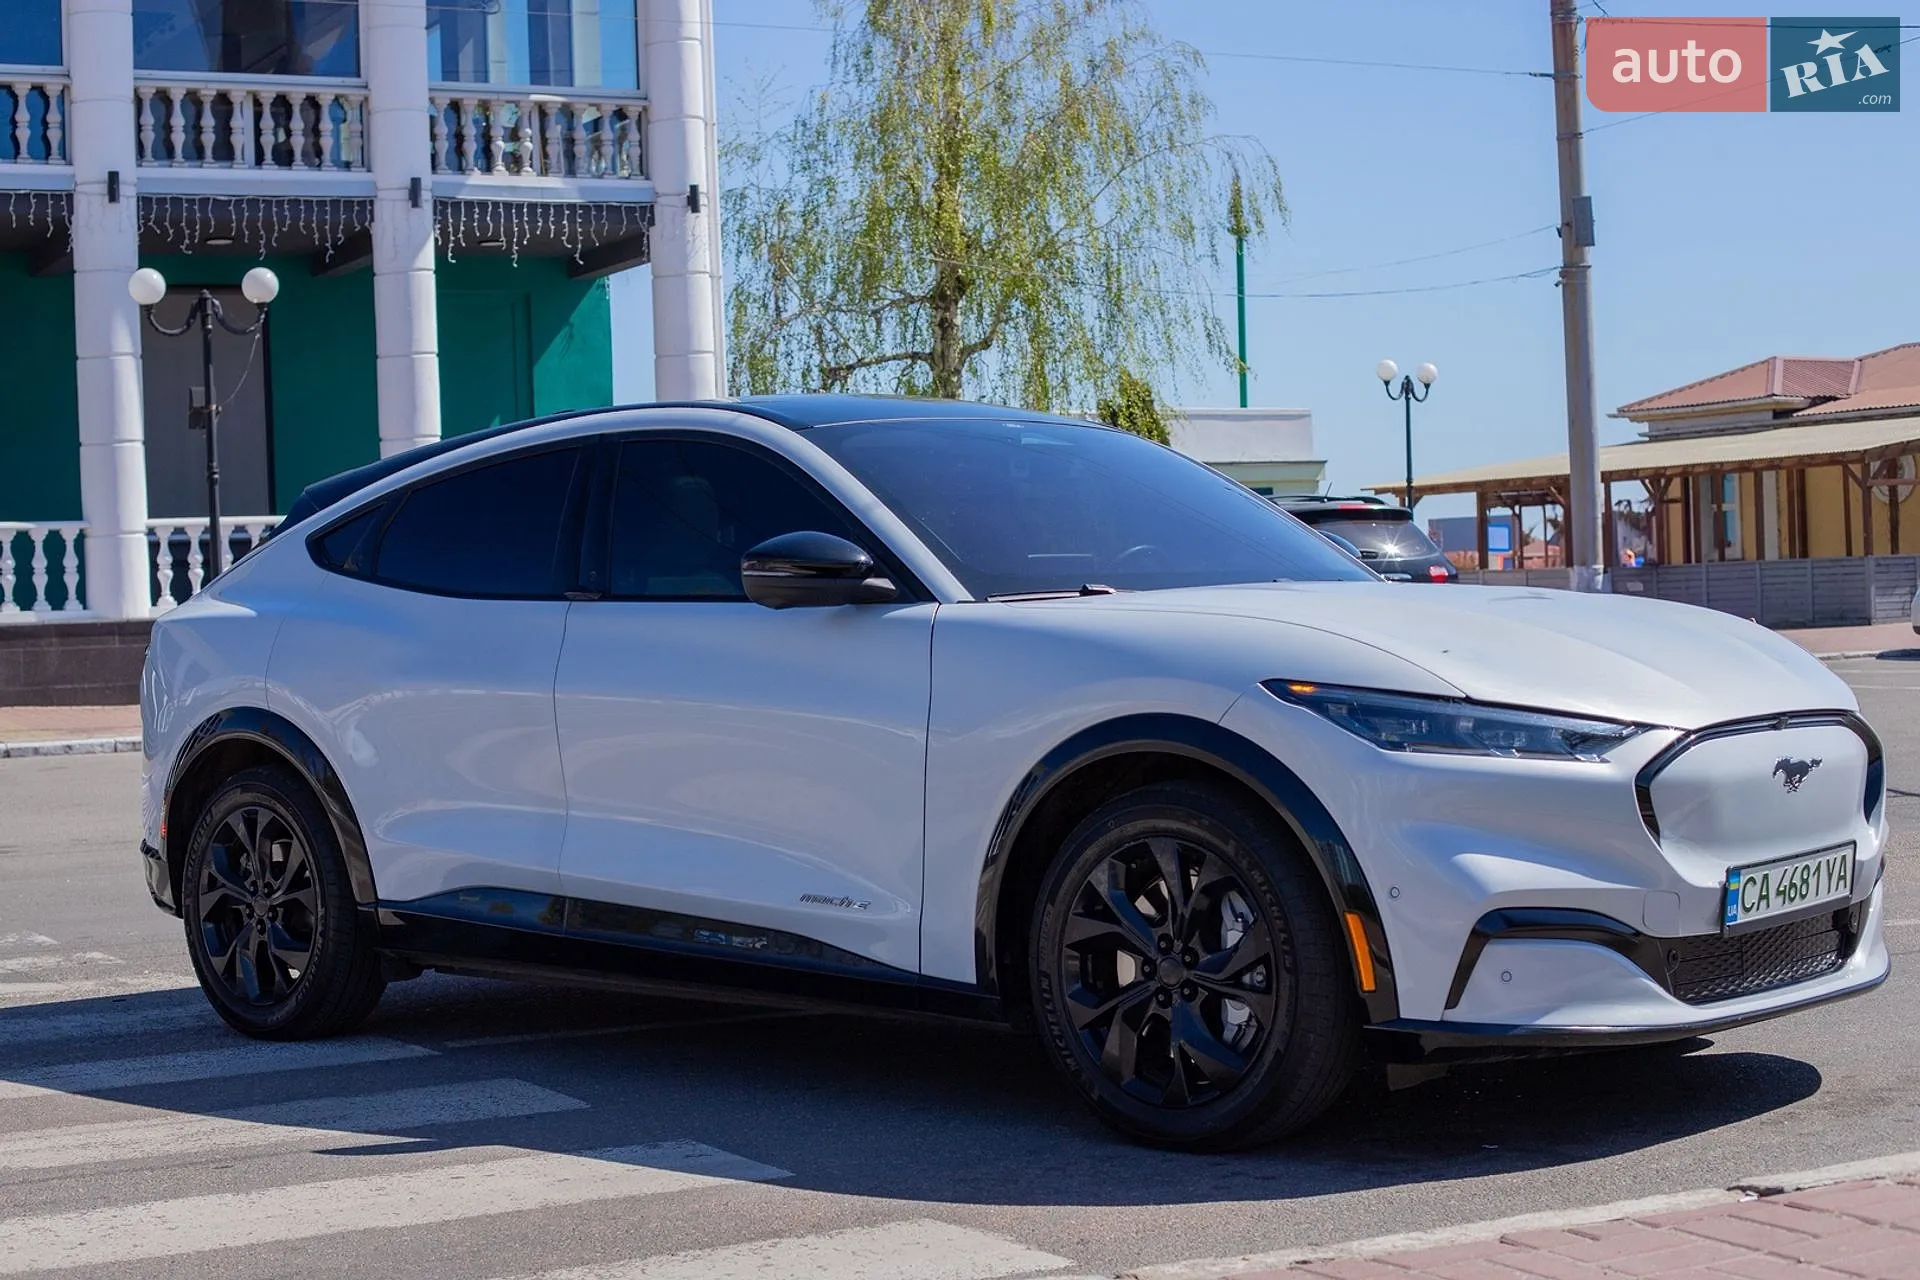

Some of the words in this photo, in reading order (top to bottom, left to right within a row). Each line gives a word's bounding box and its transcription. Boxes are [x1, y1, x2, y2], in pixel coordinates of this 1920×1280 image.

[1741, 870, 1770, 913] CA
[1776, 860, 1822, 906] 4681
[1826, 854, 1848, 895] YA
